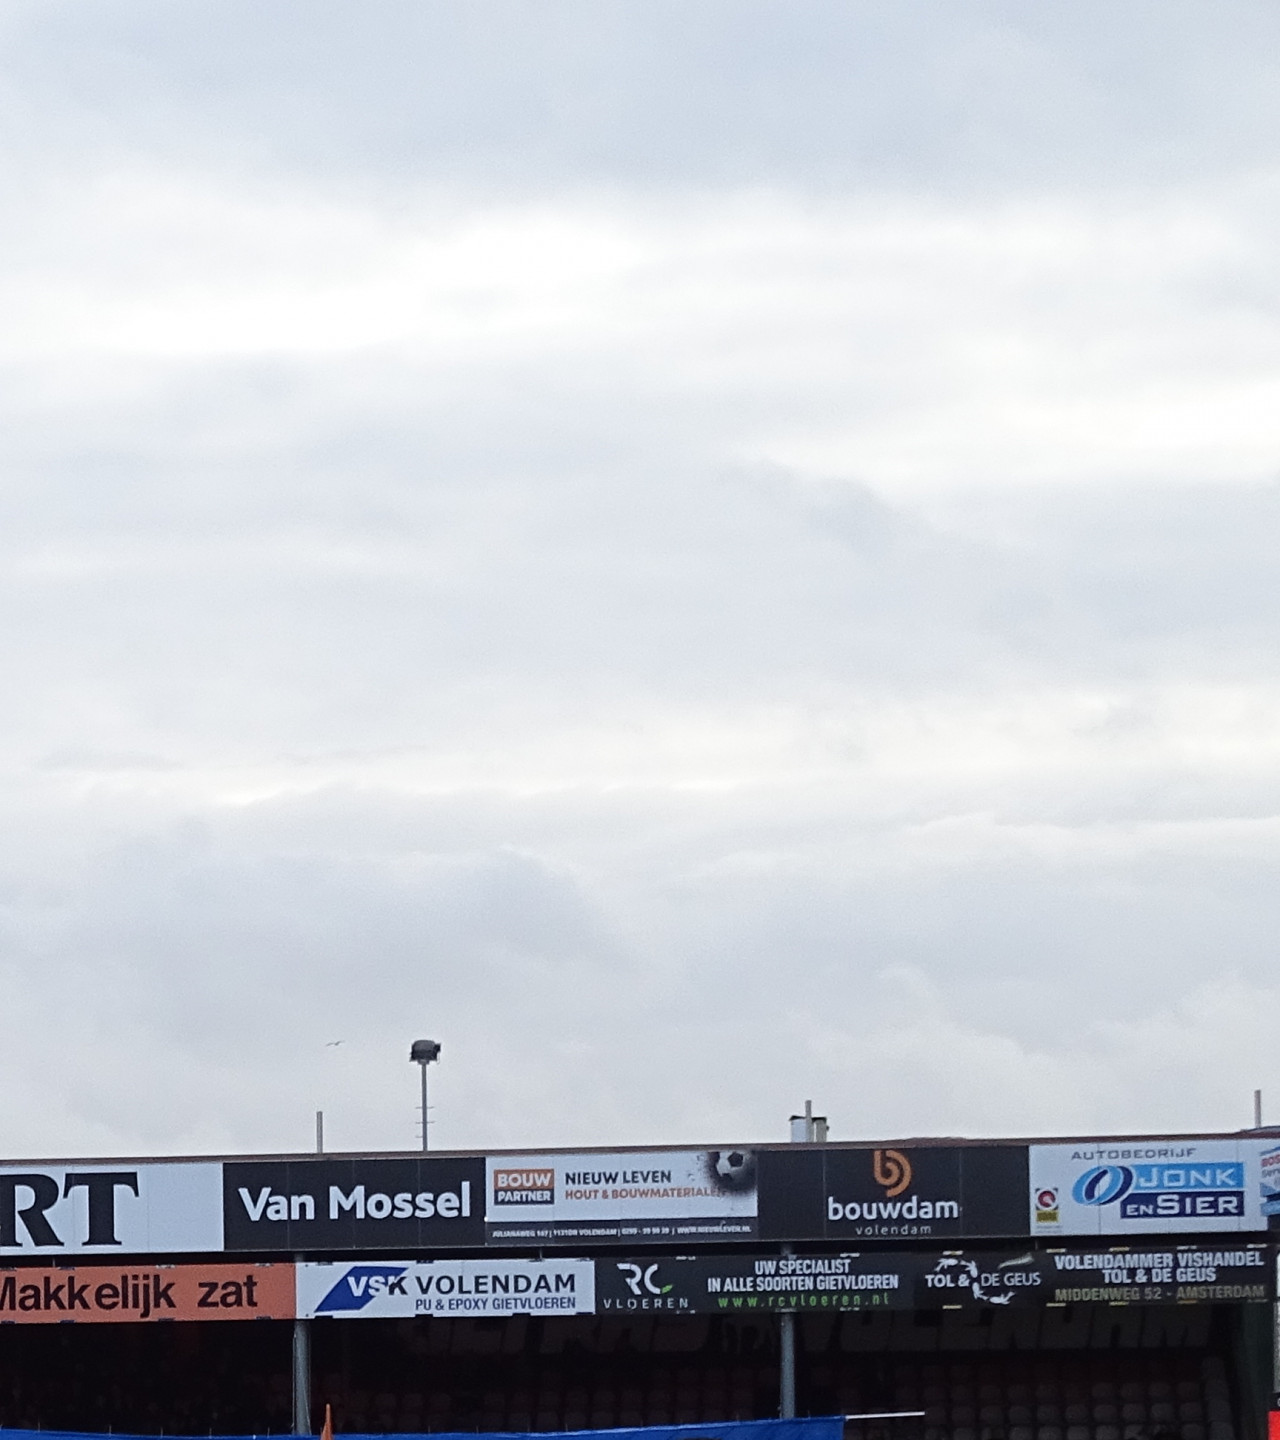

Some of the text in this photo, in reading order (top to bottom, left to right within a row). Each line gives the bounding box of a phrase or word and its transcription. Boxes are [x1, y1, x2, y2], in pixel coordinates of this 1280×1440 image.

[1071, 1147, 1197, 1160] AUTOBEDRIJF
[497, 1173, 552, 1188] BOUW
[565, 1169, 671, 1186] NIEUW LEVEN
[1141, 1167, 1236, 1187] JONK
[238, 1180, 471, 1222] Van Mossel
[497, 1189, 551, 1203] PARTNER
[565, 1188, 599, 1201] HOUT
[601, 1188, 609, 1200] &
[827, 1195, 959, 1220] bouwdam
[856, 1224, 932, 1236] volendam
[754, 1259, 851, 1275] UW SPECIALIST
[1054, 1251, 1264, 1270] VOLENDAMMER VISHANDEL
[707, 1274, 898, 1292] IN ALLE SOORTEN GIETVLOEREN
[925, 1272, 1041, 1288] TOL & DE GEUS
[1102, 1267, 1216, 1284] TOL & DE GEUS
[198, 1276, 258, 1308] zat
[347, 1273, 576, 1297] VSK VOLENDAM
[718, 1292, 889, 1308] www.rcvloeren.nl
[1055, 1287, 1140, 1302] MIDDENWEG
[1144, 1287, 1161, 1300] 52
[1176, 1285, 1265, 1300] AMSTERDAM
[415, 1296, 576, 1311] PU & EPOXY GIETVLOEREN
[604, 1297, 689, 1309] VLOEREN
